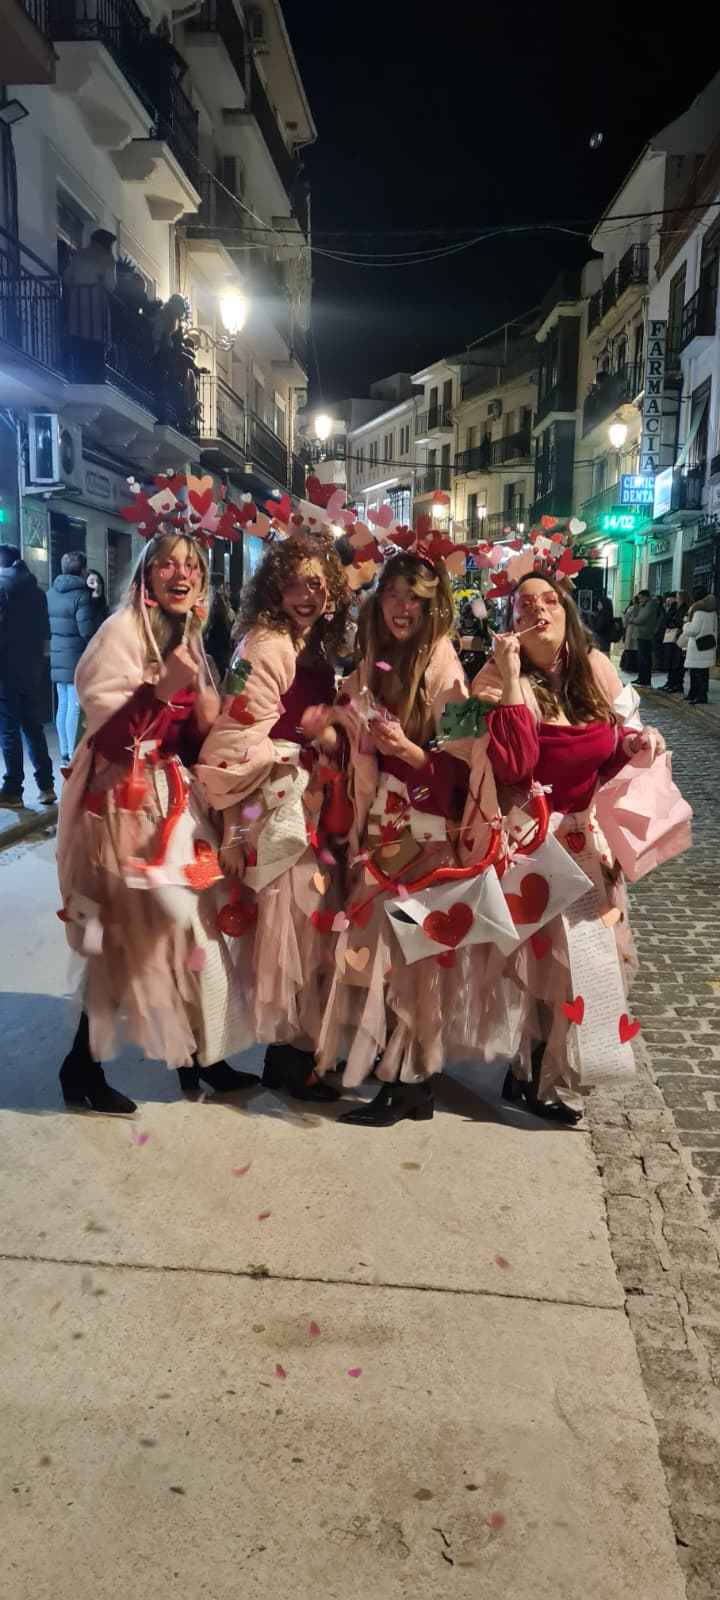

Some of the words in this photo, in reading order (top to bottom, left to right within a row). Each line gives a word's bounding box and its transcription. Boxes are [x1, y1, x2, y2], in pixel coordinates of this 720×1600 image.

[645, 321, 665, 470] FARMACIA
[624, 476, 654, 489] CLINIC
[623, 489, 654, 503] DENTA
[603, 514, 635, 531] 14/02
